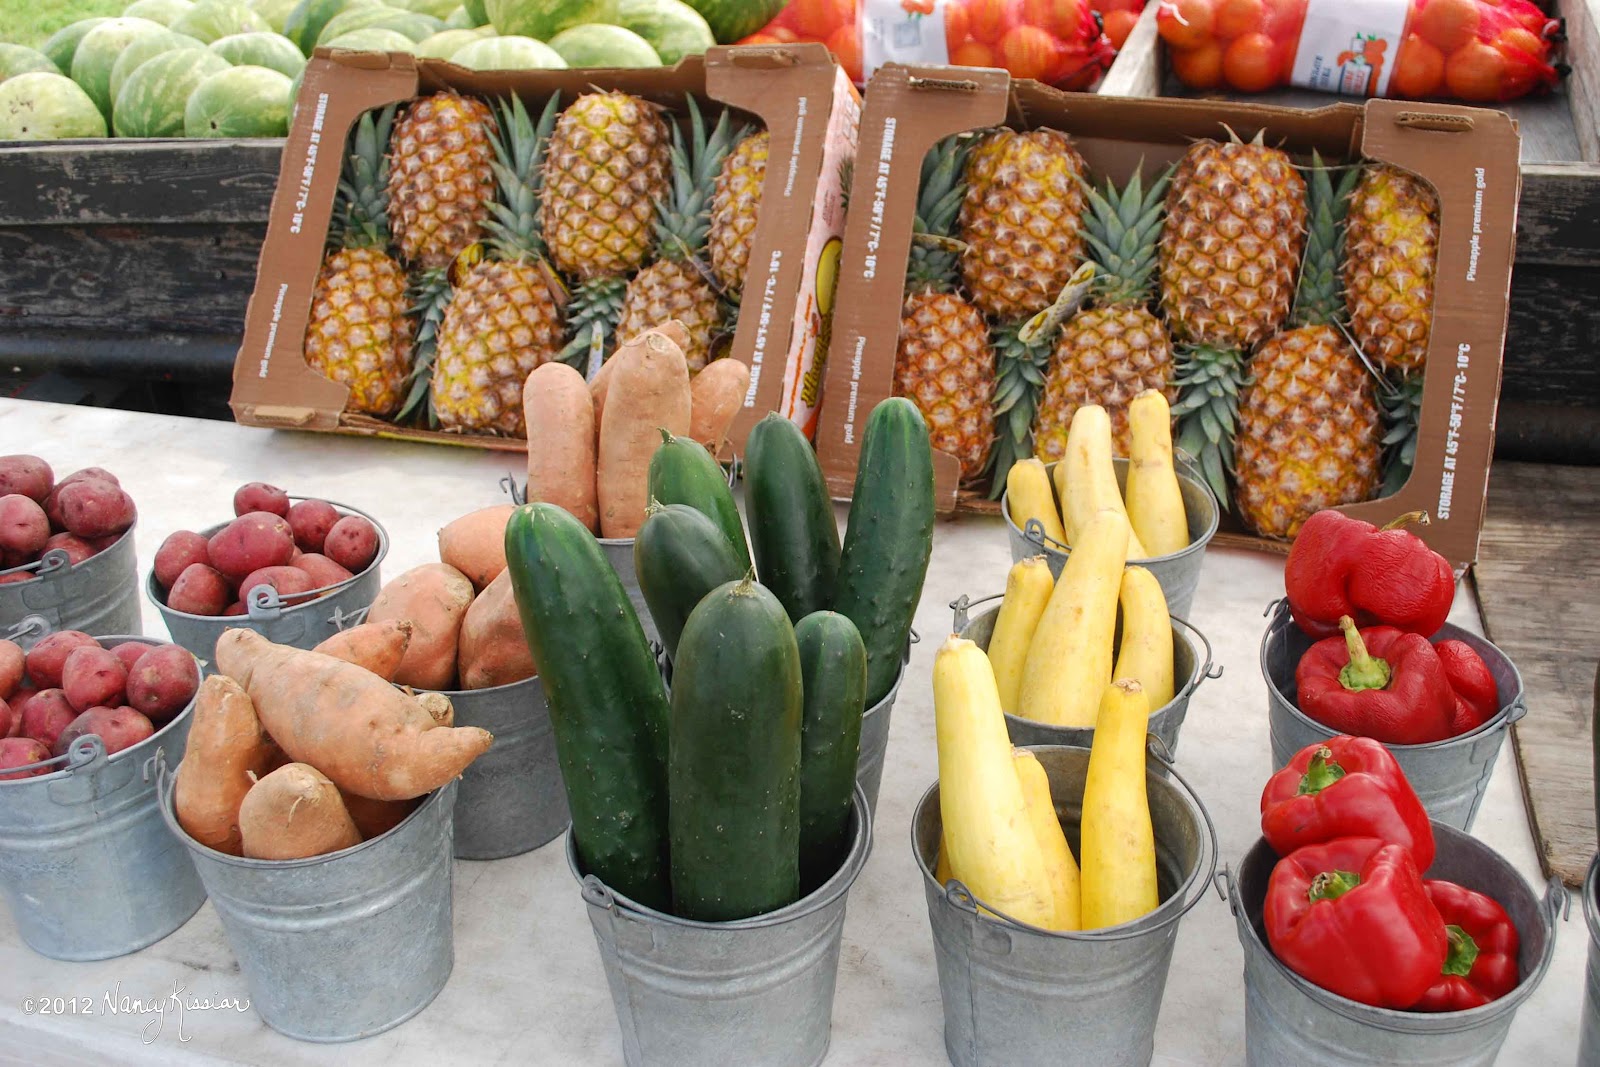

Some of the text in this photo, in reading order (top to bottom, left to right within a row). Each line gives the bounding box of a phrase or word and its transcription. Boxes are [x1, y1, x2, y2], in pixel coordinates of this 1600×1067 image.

[313, 93, 328, 131] STORAGE
[310, 132, 320, 143] AT
[784, 97, 807, 197] Pineapple premium gold
[880, 118, 896, 160] STORAGE
[878, 162, 890, 174] AT
[1467, 167, 1486, 282] Pineapple premium gold
[259, 283, 287, 378] Pineapple premium gold
[753, 351, 763, 363] AT
[845, 336, 865, 444] Pineapple premium gold
[1444, 456, 1456, 470] AT
[1438, 472, 1454, 520] STORAGE
